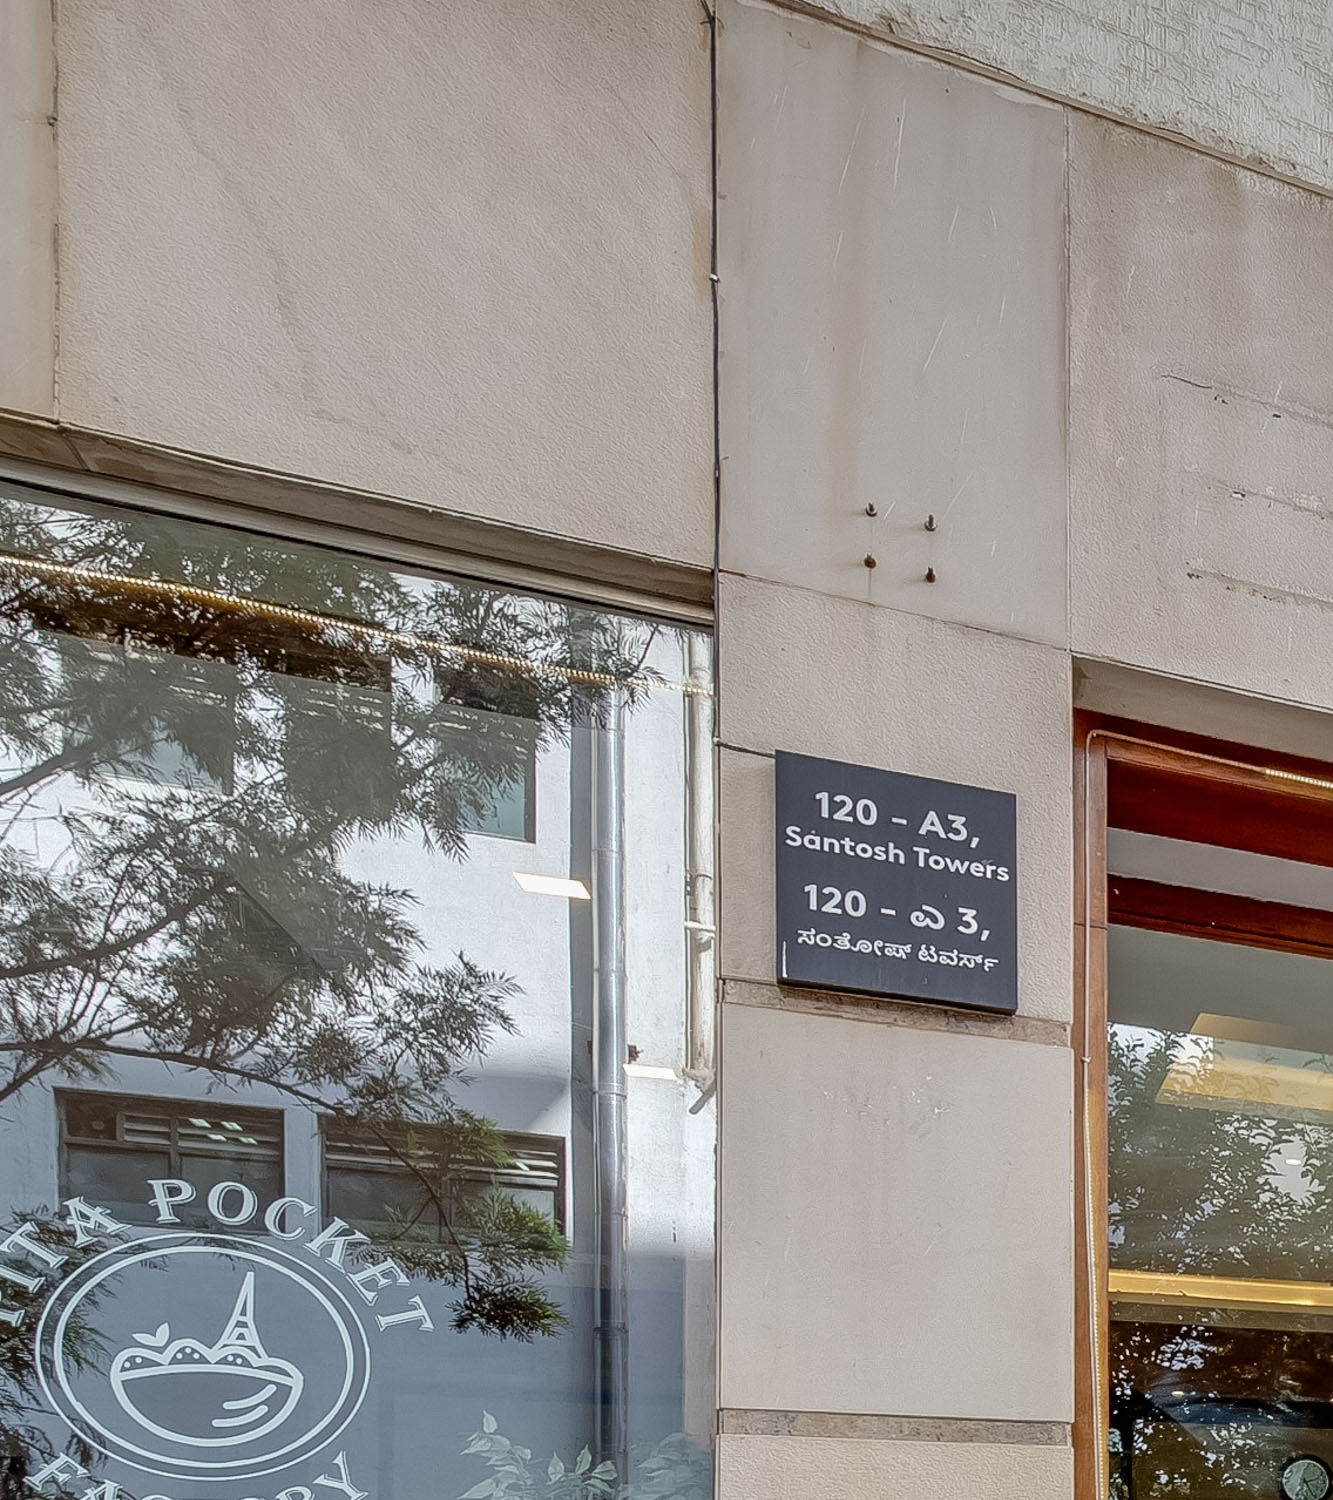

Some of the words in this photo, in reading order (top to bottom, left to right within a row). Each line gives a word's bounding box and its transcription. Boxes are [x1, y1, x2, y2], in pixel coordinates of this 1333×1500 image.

[815, 792, 877, 825] 120
[918, 811, 980, 848] A3,
[785, 826, 905, 864] Santosh
[913, 847, 1010, 881] Towers
[804, 884, 867, 917] 120
[957, 907, 990, 941] 3,
[797, 927, 912, 959] ಸಂತೋಷ್
[0, 1196, 132, 1328] ITA
[147, 1178, 434, 1333] POCKET
